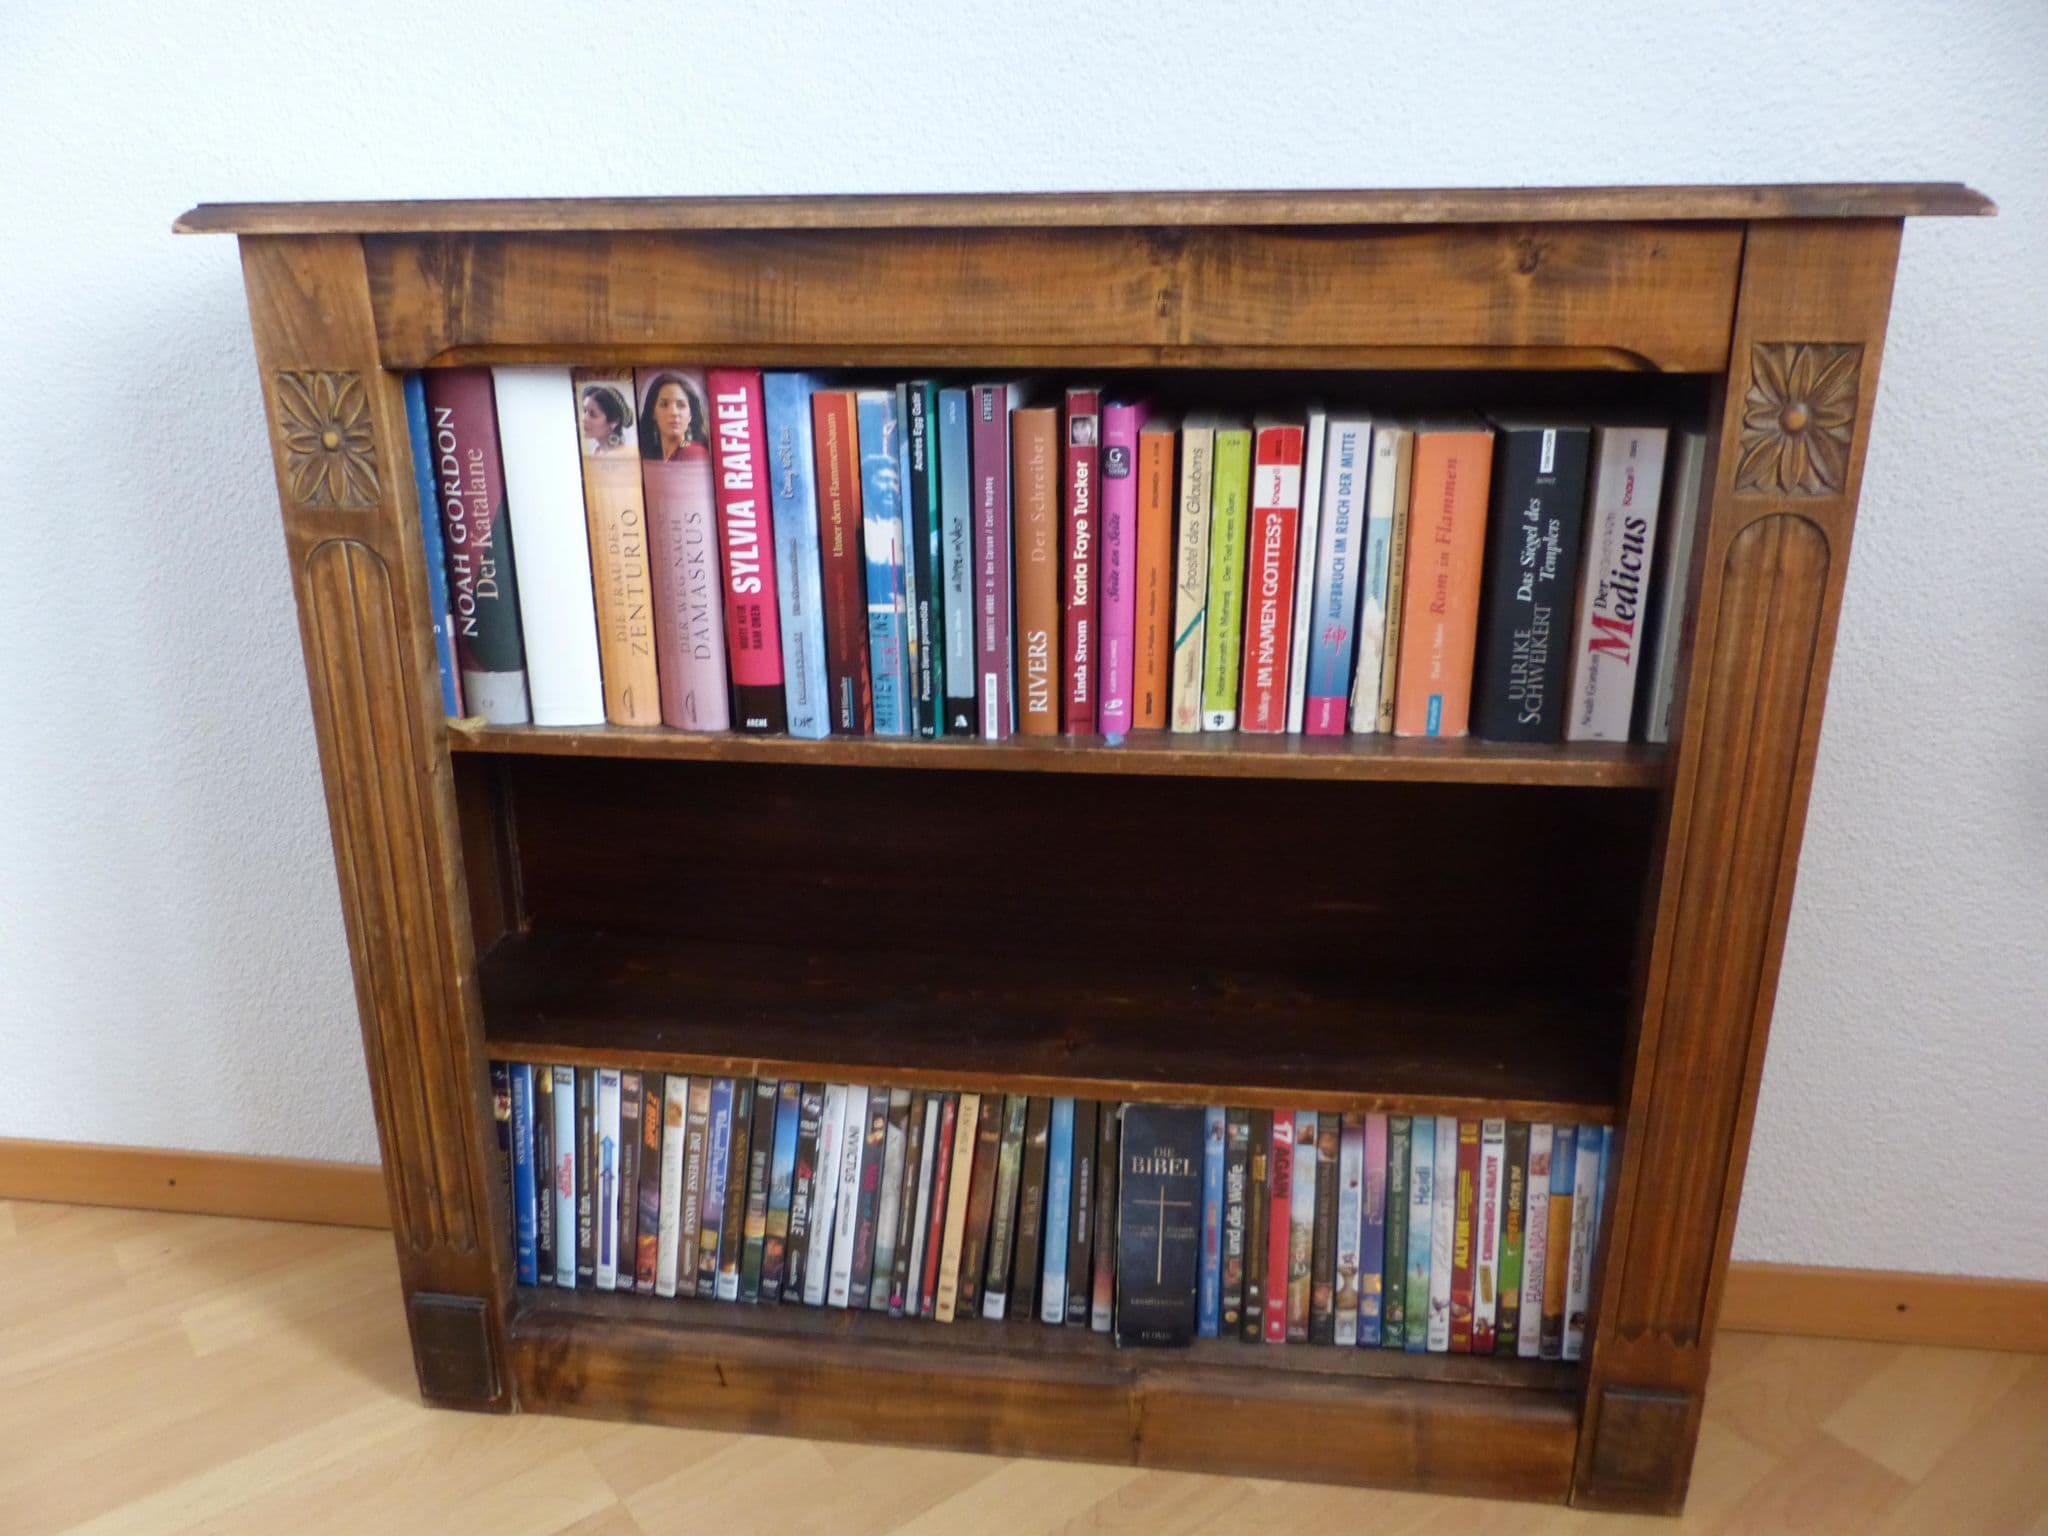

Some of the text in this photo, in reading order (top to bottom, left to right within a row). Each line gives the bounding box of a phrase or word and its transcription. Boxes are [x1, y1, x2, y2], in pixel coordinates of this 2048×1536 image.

[827, 413, 840, 496] Flammenbaum
[913, 417, 924, 436] Egg
[434, 406, 479, 637] NOAH GORDON
[466, 448, 500, 600] Der Katalane
[717, 387, 762, 594] SYLVIA RAFAEL
[831, 500, 842, 524] dem
[1030, 435, 1046, 562] Der Schreiber
[1180, 447, 1203, 602] Apostel des Glaubens
[1329, 432, 1356, 619] AUFBRUCH IM REICH DER MITTE
[1073, 460, 1091, 605] Karla Faye Tucker
[1107, 513, 1121, 602] Seite an Seite
[1429, 456, 1458, 614] Rom in Flammen
[1517, 498, 1541, 602] Das Siegel des
[1539, 518, 1563, 582] Templers
[621, 509, 649, 656] ZENTURIO
[685, 511, 711, 660] DAMASKUS
[919, 601, 931, 645] prometida
[1257, 513, 1282, 687] IM NAMEN GOTTES?
[1587, 516, 1648, 665] Medicus
[1593, 579, 1608, 609] Der
[1028, 630, 1048, 712] RIVERS
[1075, 620, 1087, 703] Linda Strom
[1508, 628, 1531, 700] ULRIKE
[1518, 603, 1551, 725] SCHWEIKERT
[687, 1154, 700, 1193] WEISSE
[689, 1132, 701, 1153] DIE
[844, 1126, 860, 1184] INVICTUS
[1131, 1157, 1197, 1177] BIBEL
[1273, 1121, 1292, 1199] 17 AGAIN
[790, 1194, 808, 1236] WELLE
[1413, 1165, 1432, 1206] Heidi
